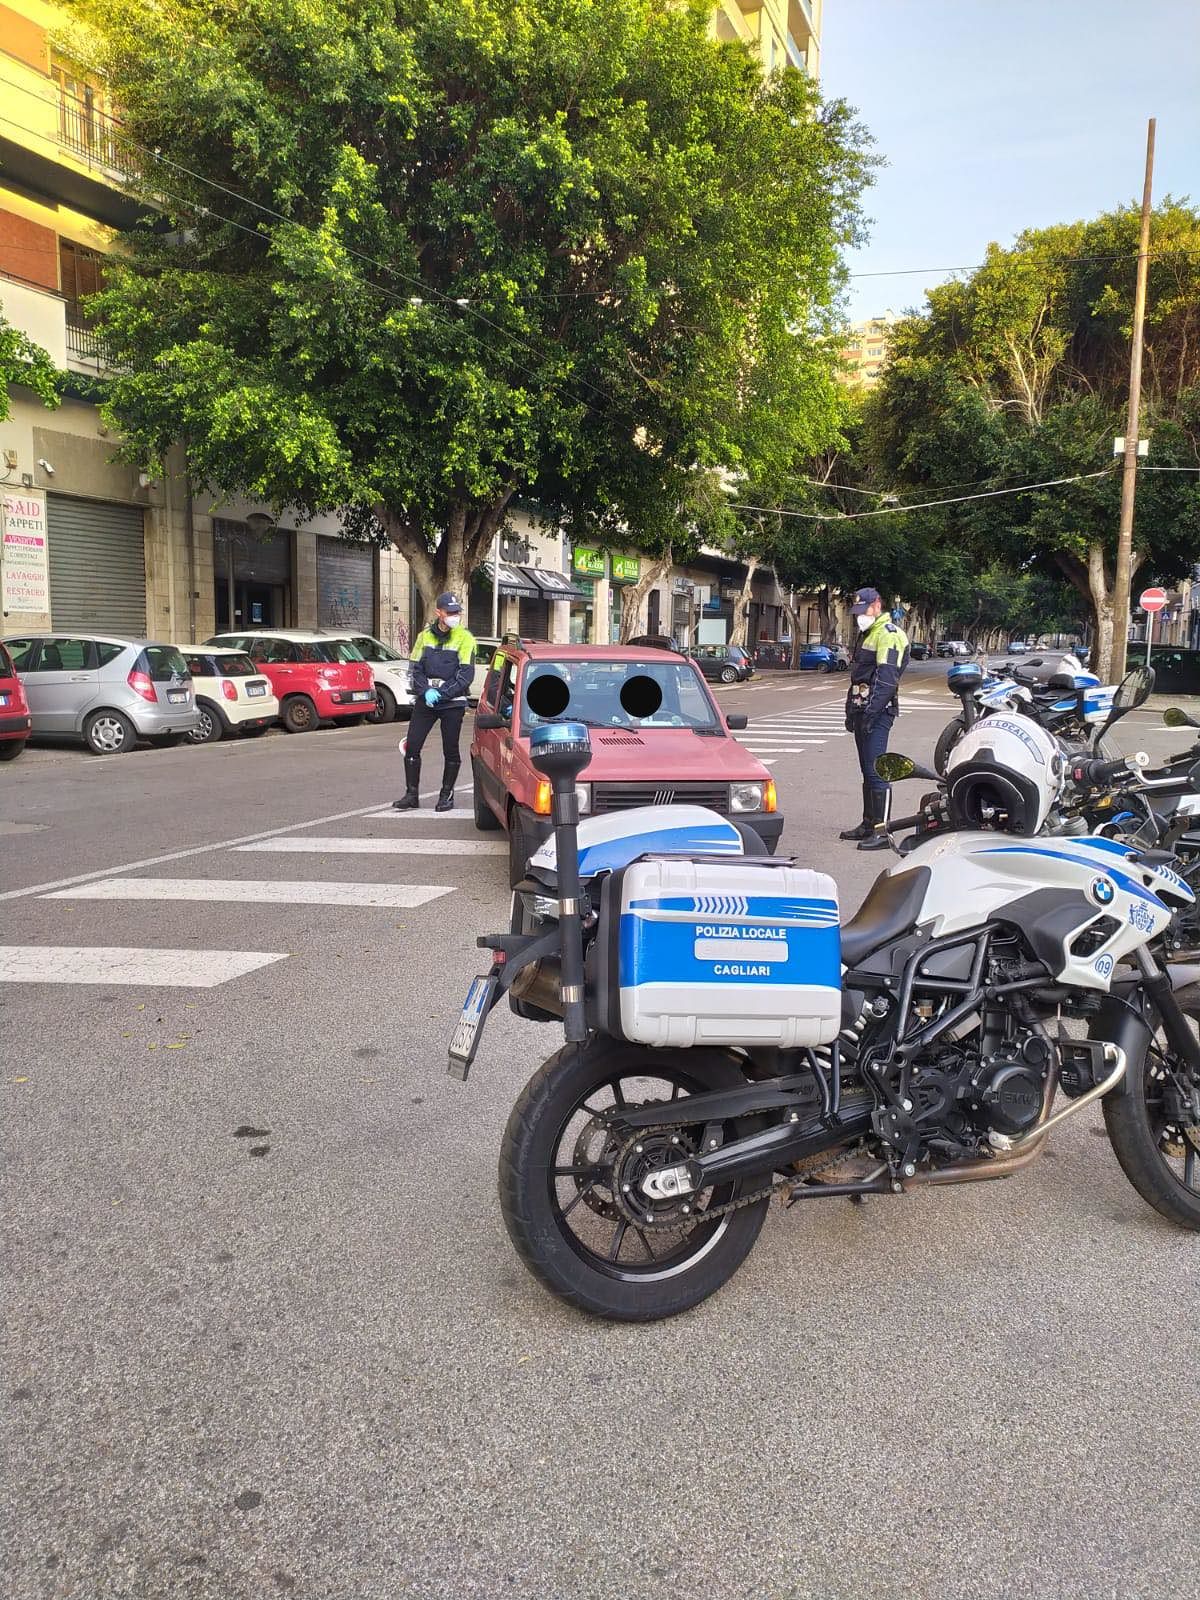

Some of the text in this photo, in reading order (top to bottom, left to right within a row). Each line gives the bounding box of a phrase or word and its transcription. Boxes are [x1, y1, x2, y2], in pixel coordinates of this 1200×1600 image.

[5, 498, 40, 517] SAID
[4, 517, 43, 531] TAPPETI
[9, 535, 37, 546] VENDITA
[6, 571, 44, 581] LAVAGGIO
[7, 587, 45, 597] RESTAURO
[695, 926, 787, 939] POLIZIA LOCALE
[713, 964, 770, 976] CAGLIARI
[1097, 960, 1111, 974] 09
